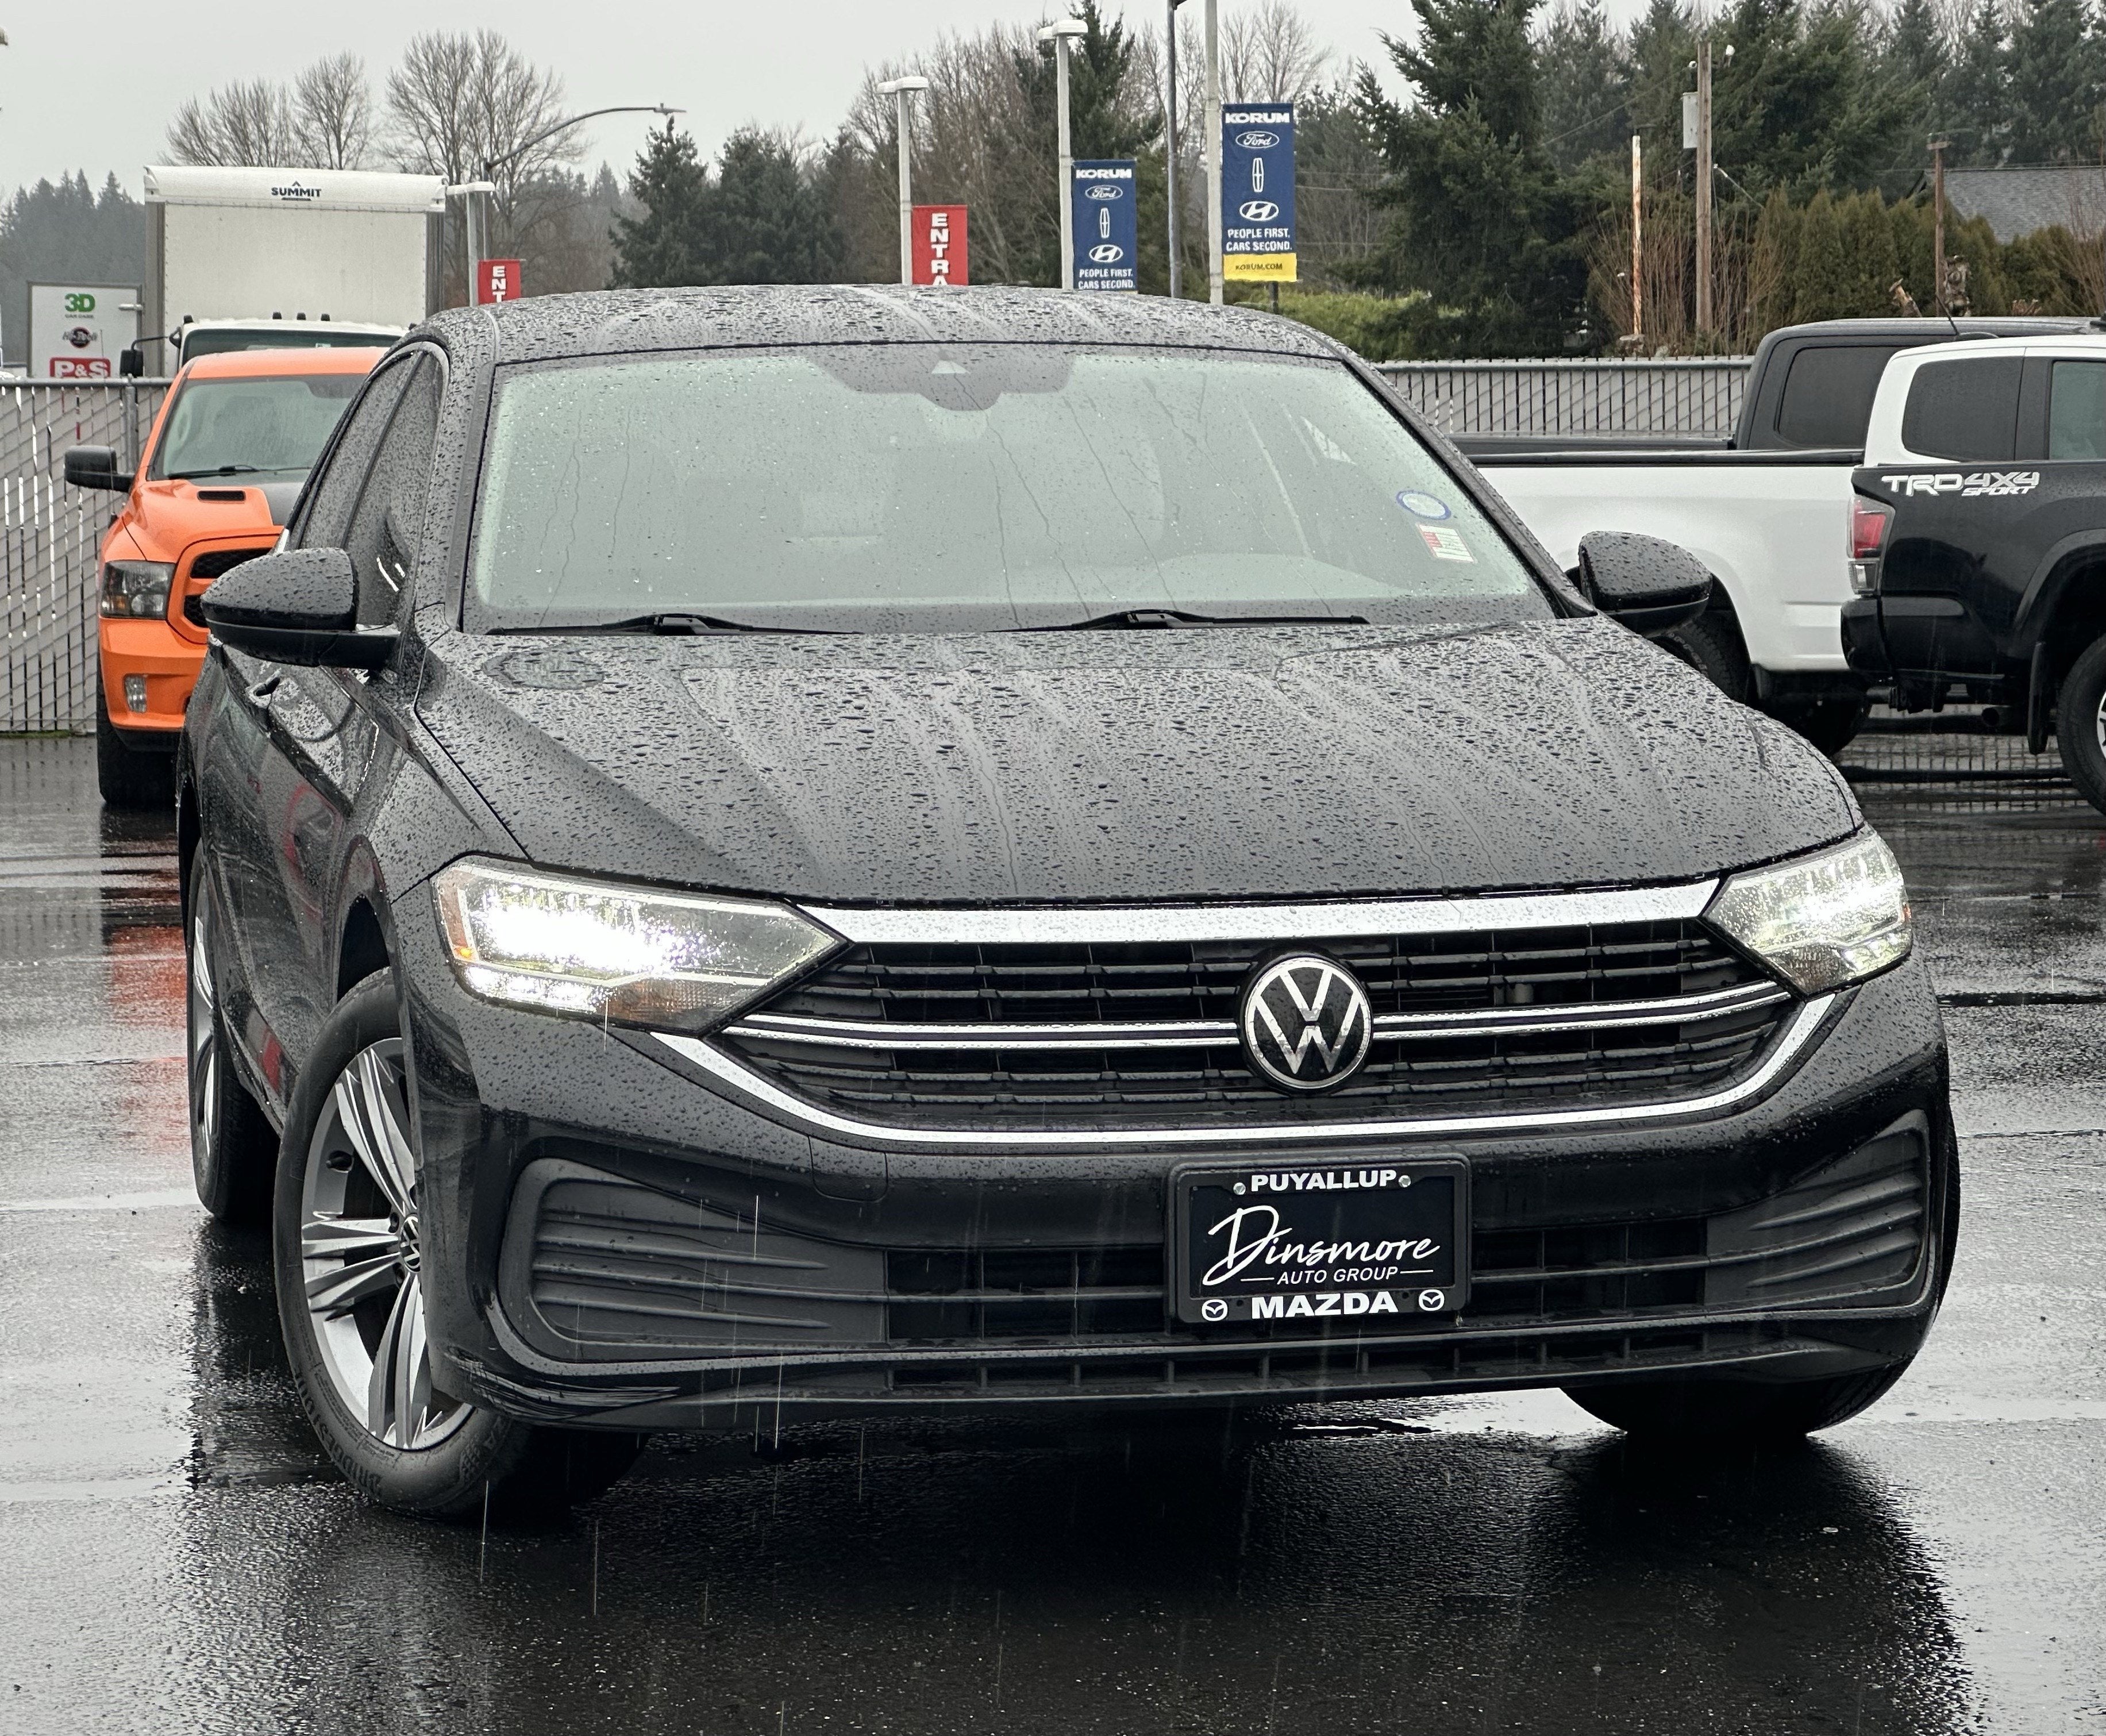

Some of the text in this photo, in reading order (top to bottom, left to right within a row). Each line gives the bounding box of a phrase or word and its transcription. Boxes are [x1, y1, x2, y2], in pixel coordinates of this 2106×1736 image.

[1225, 113, 1289, 123] KORUM
[1243, 133, 1272, 145] Ford
[1076, 169, 1132, 179] KORUM
[271, 187, 322, 197] SUMMIT
[1092, 187, 1116, 198] Ford
[1227, 228, 1290, 238] PEOPLE FIRST.
[1226, 241, 1292, 251] CARS SECOND.
[1079, 268, 1133, 278] PEOPLE FIRST.
[1078, 279, 1135, 289] CARS SECOND.
[64, 293, 95, 312] 3D
[54, 361, 109, 378] P&S
[1881, 474, 1964, 496] TRD
[1961, 486, 2036, 496] SPORT
[1251, 1169, 1397, 1192] PUYALLUP
[1202, 1205, 1441, 1286] Dinsmore
[1277, 1266, 1398, 1285] AUTO GROUP
[1252, 1291, 1399, 1319] MAZDA
